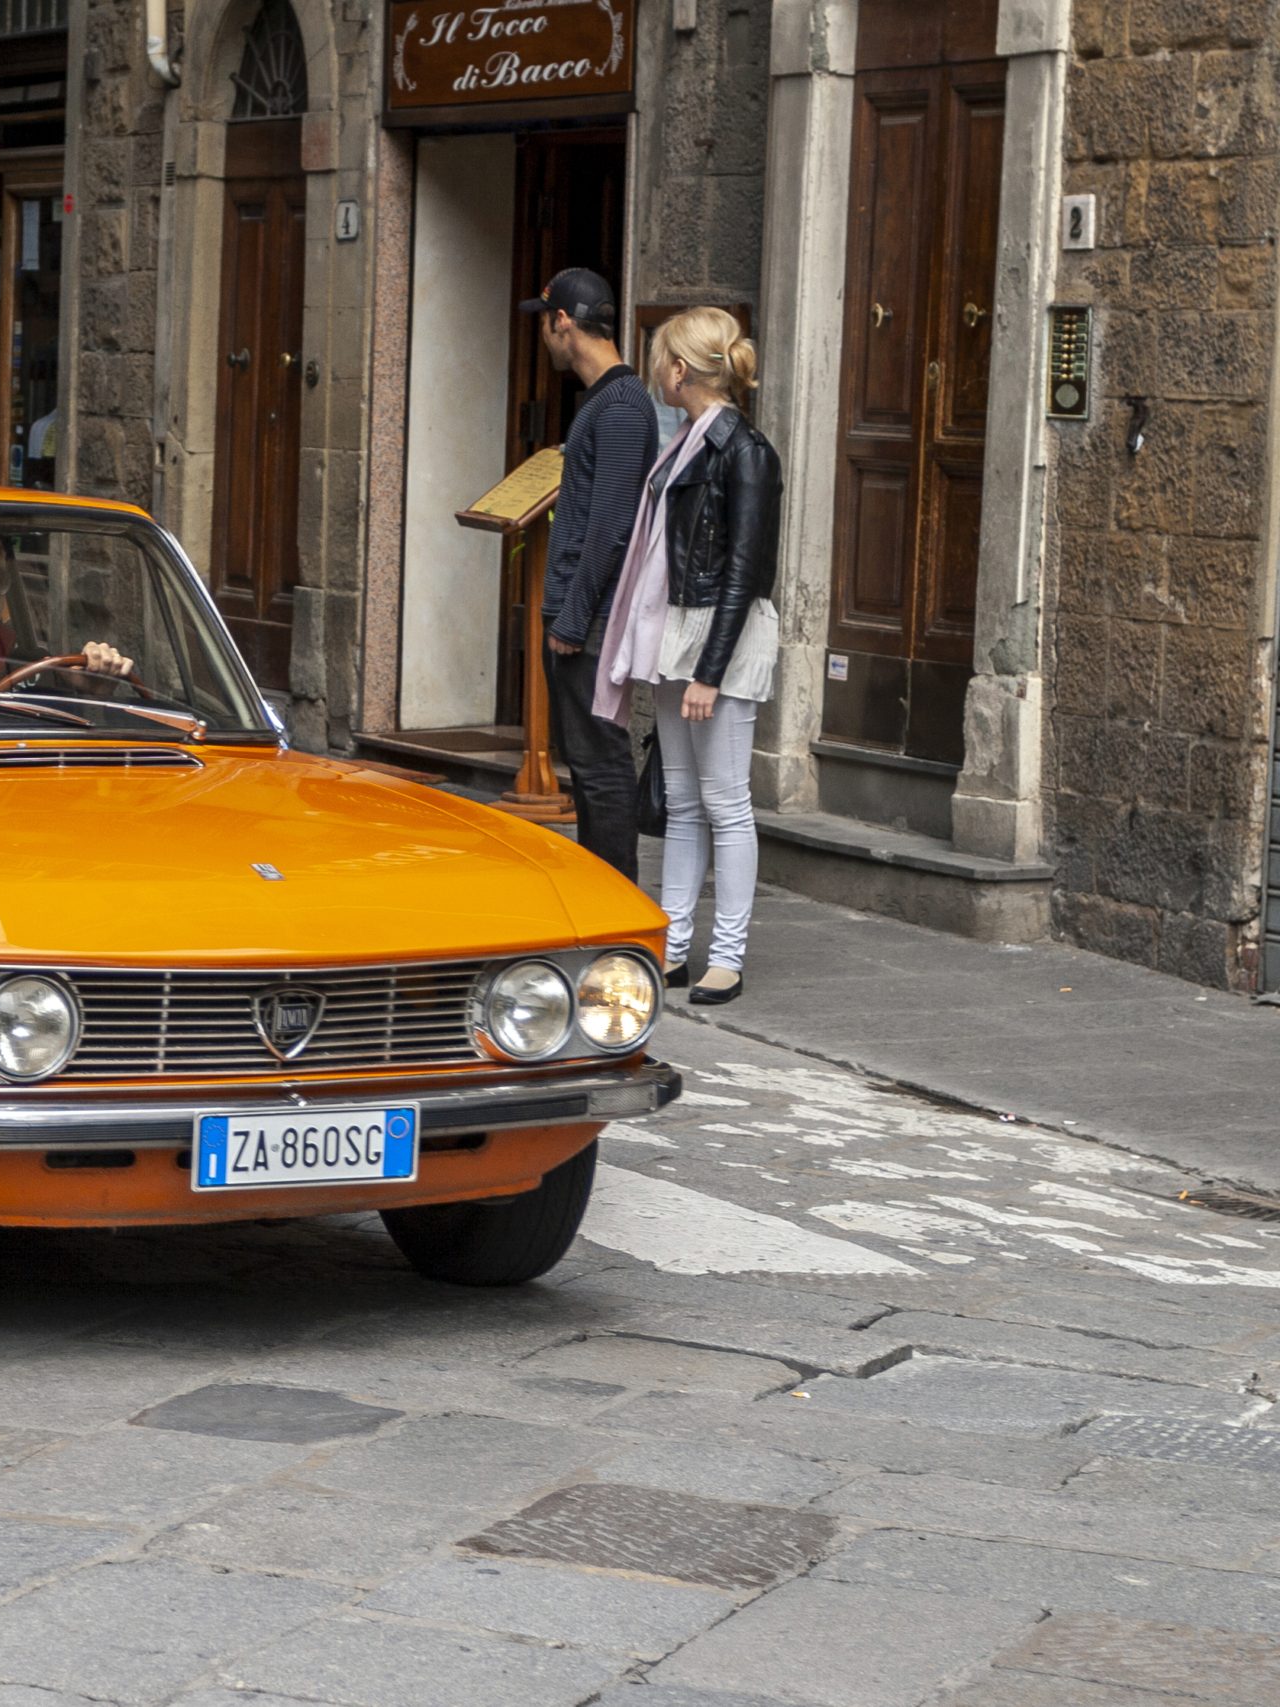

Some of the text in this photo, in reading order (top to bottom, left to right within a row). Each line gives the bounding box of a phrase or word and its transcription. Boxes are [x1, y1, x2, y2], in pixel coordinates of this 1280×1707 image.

[420, 8, 548, 46] Il Tocco
[453, 51, 592, 91] di Bacco
[1070, 206, 1083, 239] 2
[232, 1130, 269, 1172] ZA
[281, 1125, 382, 1168] 860SG
